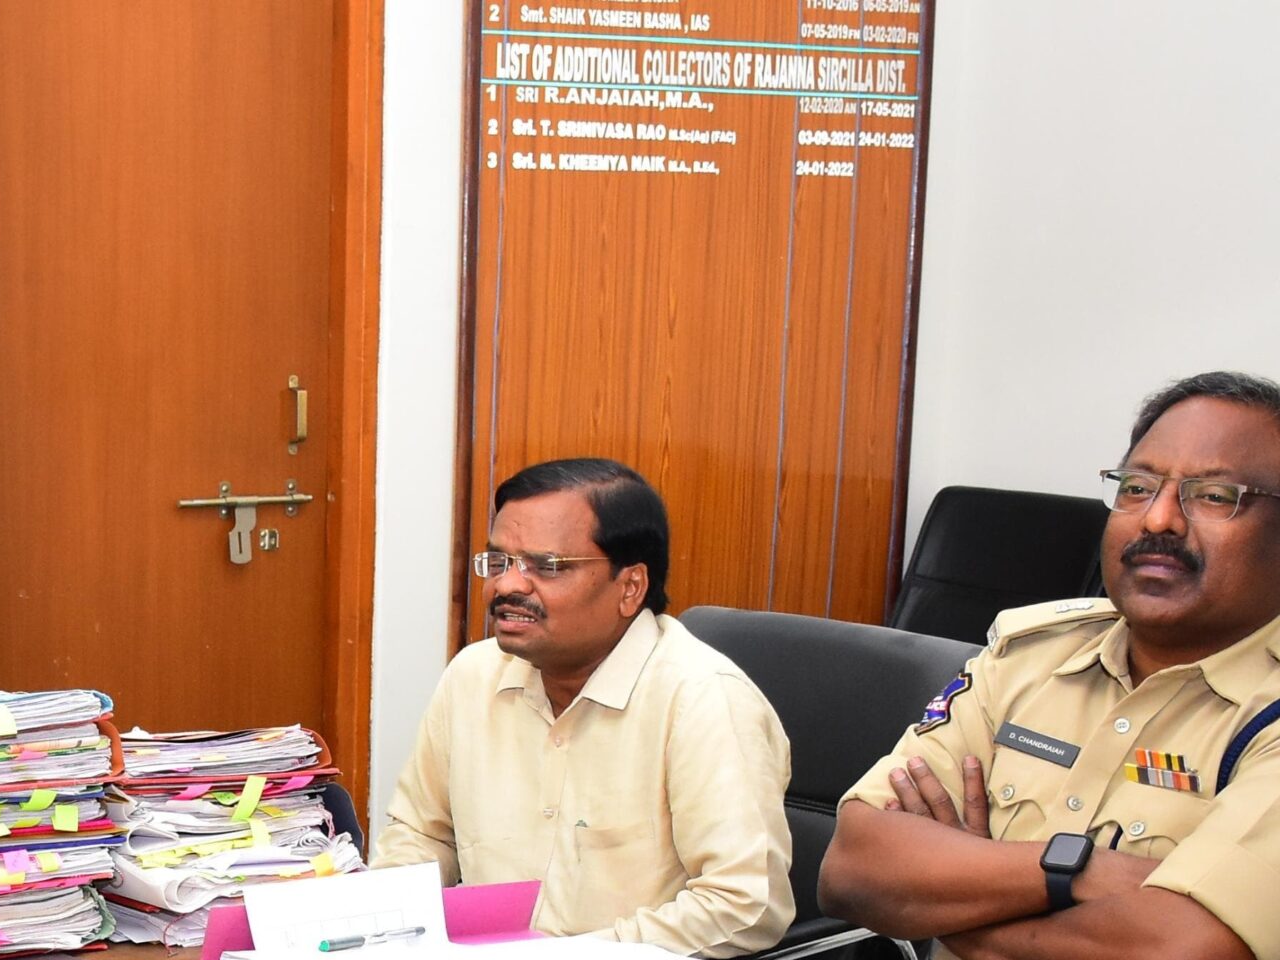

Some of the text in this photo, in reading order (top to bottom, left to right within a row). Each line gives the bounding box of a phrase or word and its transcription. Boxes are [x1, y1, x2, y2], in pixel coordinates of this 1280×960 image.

[489, 4, 500, 22] 2
[520, 5, 548, 23] Smt.
[549, 7, 586, 26] SHAIK
[588, 9, 642, 28] YASMEEN
[643, 12, 681, 30] BASHA
[690, 14, 710, 32] IAS
[496, 43, 907, 94] LIST OF ADDITIONAL COLLECTORS OF RAJANNA SIRCILLA DIST.
[486, 85, 497, 102] 1
[516, 87, 538, 103] SRI
[800, 97, 844, 114] 12-02-2020
[860, 101, 915, 118] 17-05-2021
[488, 119, 498, 136] 2
[540, 120, 555, 137] T.
[557, 121, 634, 139] SRINIVASA
[636, 124, 667, 141] RAO
[798, 130, 855, 147] 03-09-2021
[858, 131, 914, 148] 24-01-2022
[487, 151, 497, 169] 3
[631, 157, 667, 172] NAIK
[795, 160, 853, 176] 24-01-2022
[1008, 732, 1065, 756] D. CHANDRAIAH
